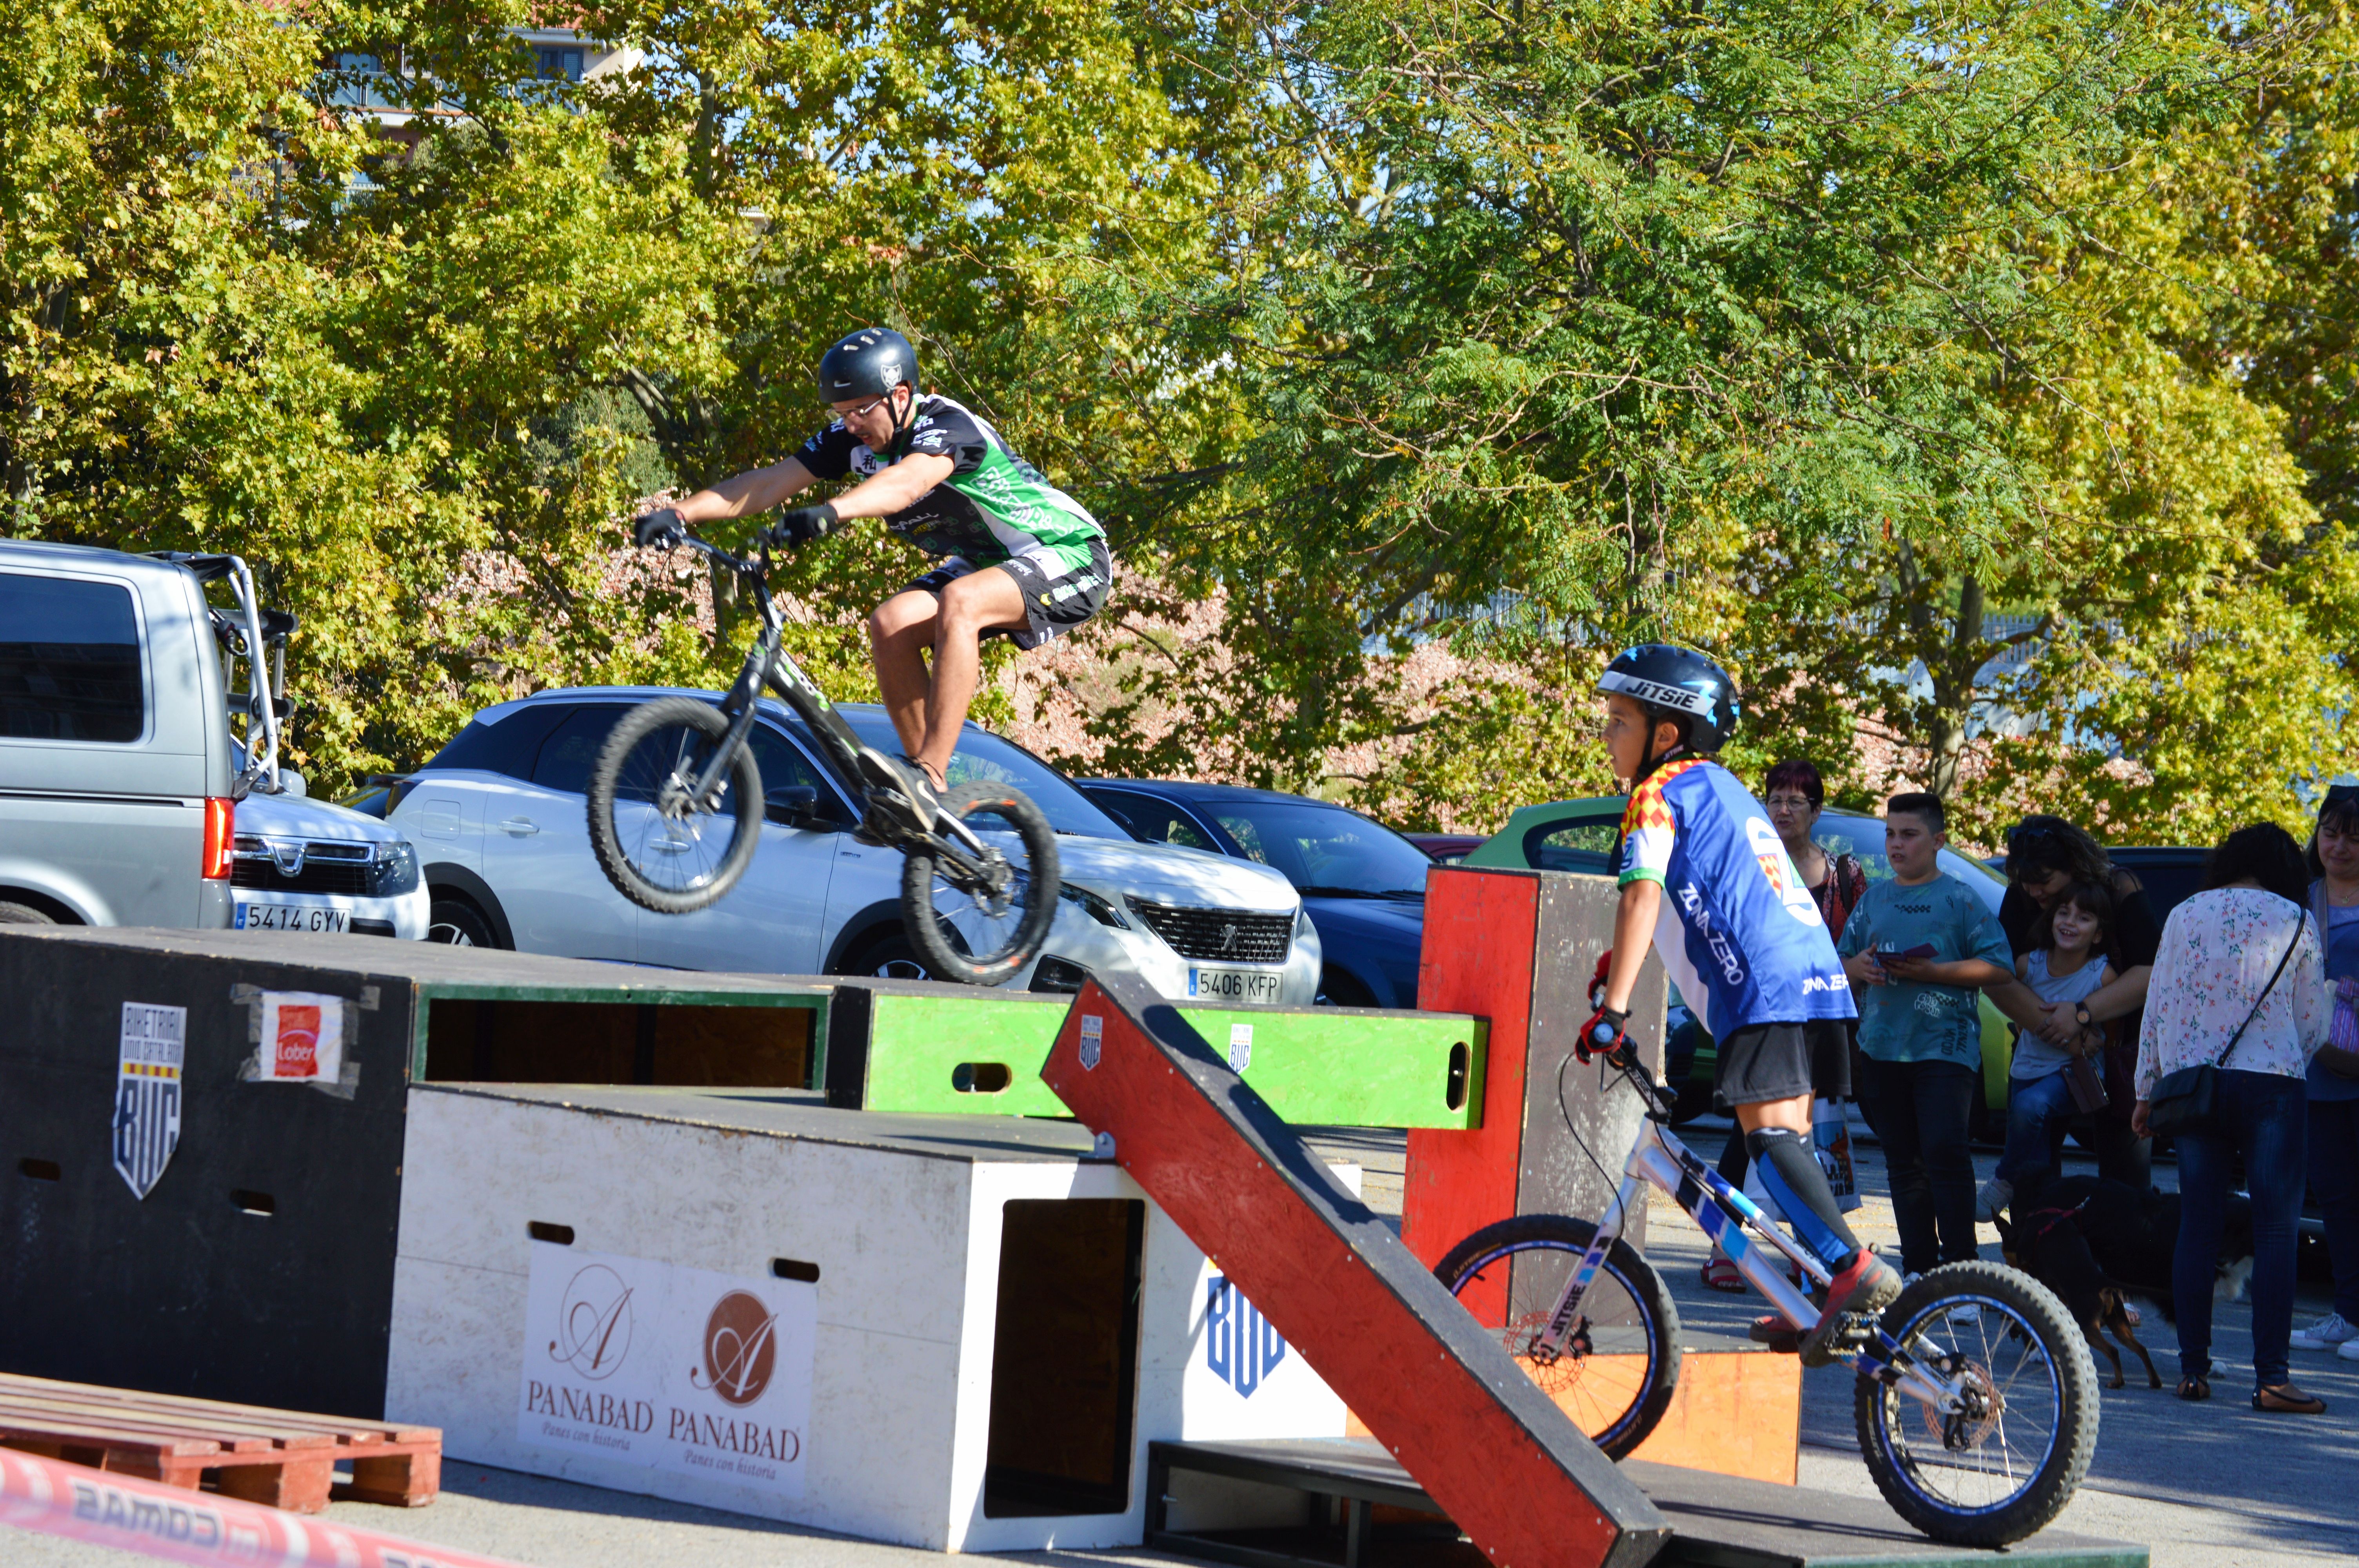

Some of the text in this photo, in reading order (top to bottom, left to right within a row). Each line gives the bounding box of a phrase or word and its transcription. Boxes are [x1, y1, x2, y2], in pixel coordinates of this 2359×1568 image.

[249, 906, 302, 931] 5414
[311, 911, 345, 932] GYV
[1708, 931, 1744, 985] ZERO
[1200, 973, 1242, 995] 5406
[1248, 976, 1277, 997] KFP
[1230, 1044, 1249, 1073] BUC
[527, 1380, 654, 1434] PANABAD
[542, 1420, 631, 1450] Panes con historia
[669, 1407, 800, 1463] PANABAD
[683, 1450, 776, 1481] Panes con historia
